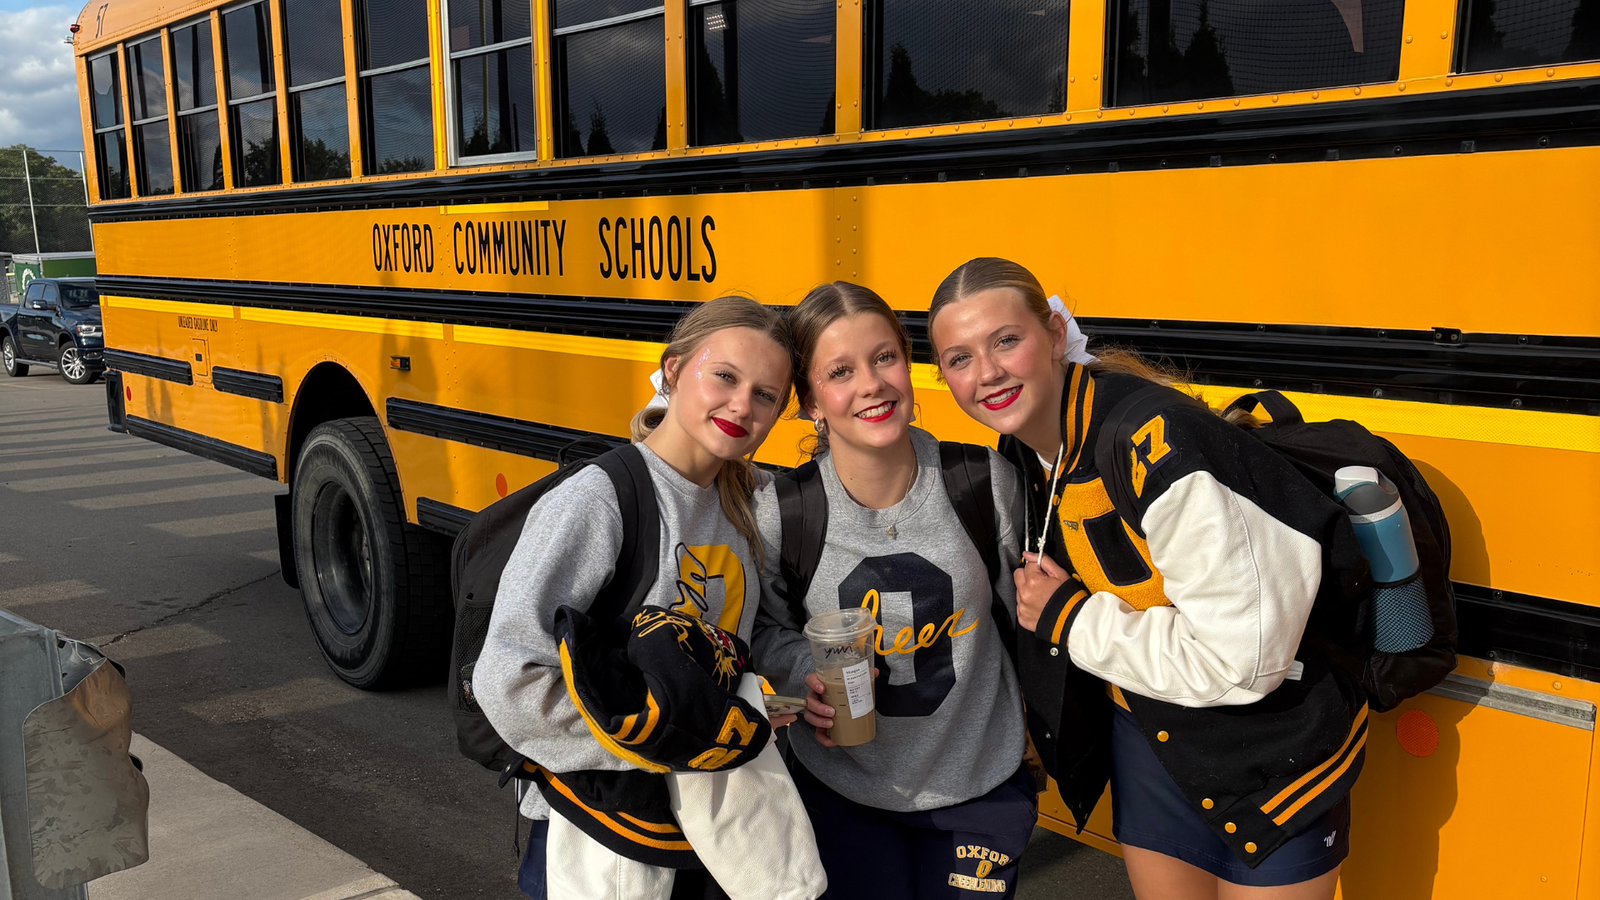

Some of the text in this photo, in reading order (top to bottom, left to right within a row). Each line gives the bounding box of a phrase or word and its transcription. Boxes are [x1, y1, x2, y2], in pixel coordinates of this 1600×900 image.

[95, 3, 109, 38] 57
[372, 214, 717, 283] OXFORD COMMUNITY SCHOOLS
[860, 589, 980, 656] heer
[688, 706, 758, 770] 27
[956, 845, 1013, 867] OXFOR
